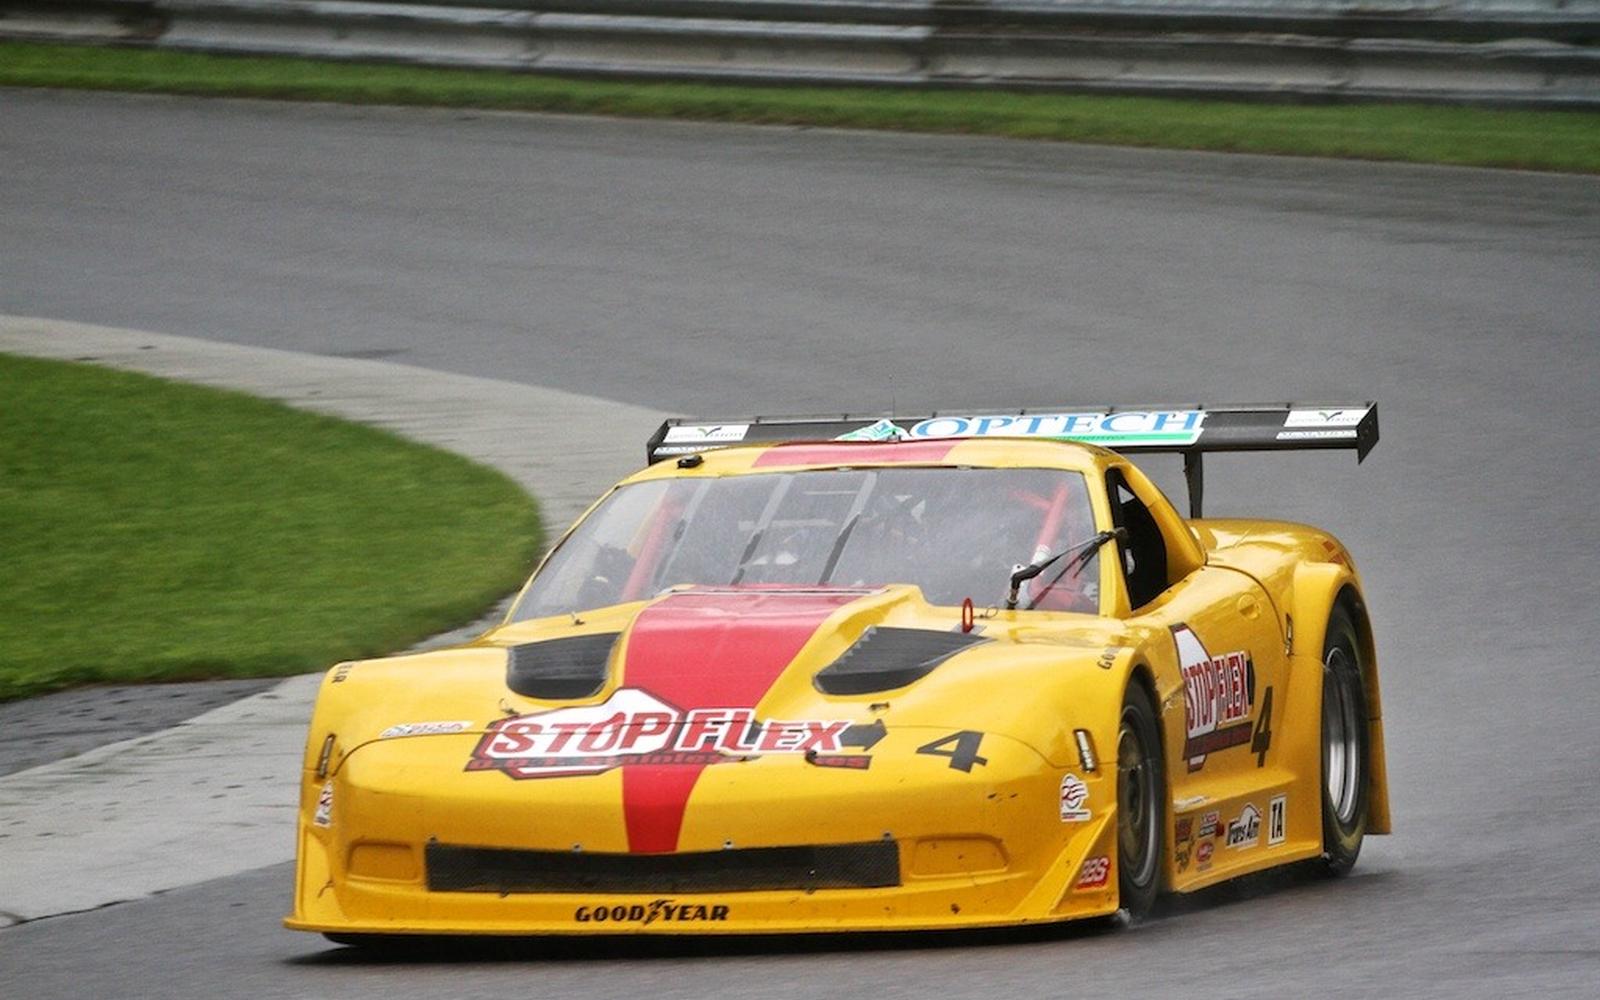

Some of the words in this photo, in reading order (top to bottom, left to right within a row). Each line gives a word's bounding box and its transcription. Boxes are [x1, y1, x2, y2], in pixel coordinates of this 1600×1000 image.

[919, 411, 1203, 436] OPTECH
[492, 711, 672, 754] STOP
[679, 709, 852, 752] FLEX
[1251, 686, 1272, 768] 4
[916, 730, 988, 773] 4
[1271, 800, 1283, 840] TA
